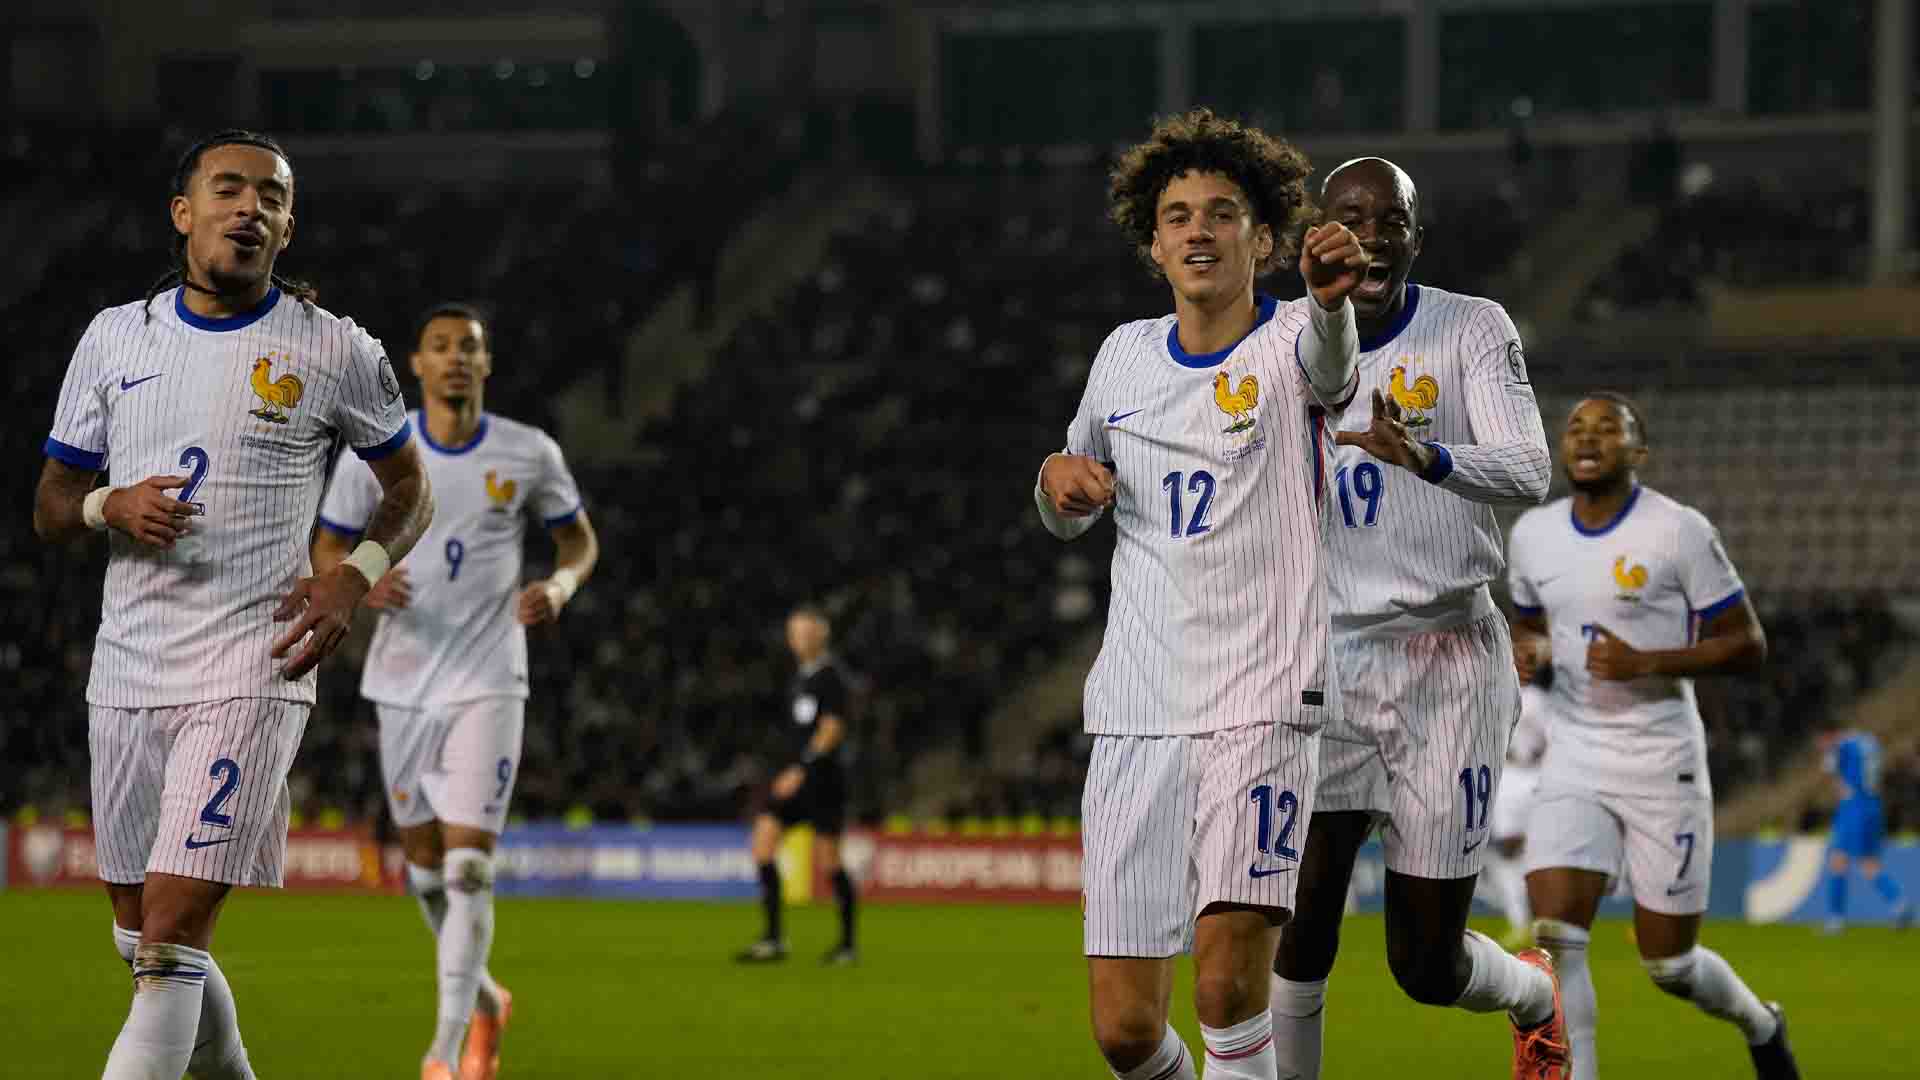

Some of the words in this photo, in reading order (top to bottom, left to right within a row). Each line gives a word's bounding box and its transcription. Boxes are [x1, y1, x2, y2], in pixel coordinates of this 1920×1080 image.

[177, 446, 210, 516] 2
[1162, 470, 1217, 538] 12
[1335, 462, 1384, 528] 19
[445, 538, 464, 581] 9
[200, 758, 241, 828] 2
[496, 757, 512, 798] 9
[1459, 764, 1491, 832] 19
[1251, 784, 1298, 862] 12
[1674, 832, 1695, 879] 7
